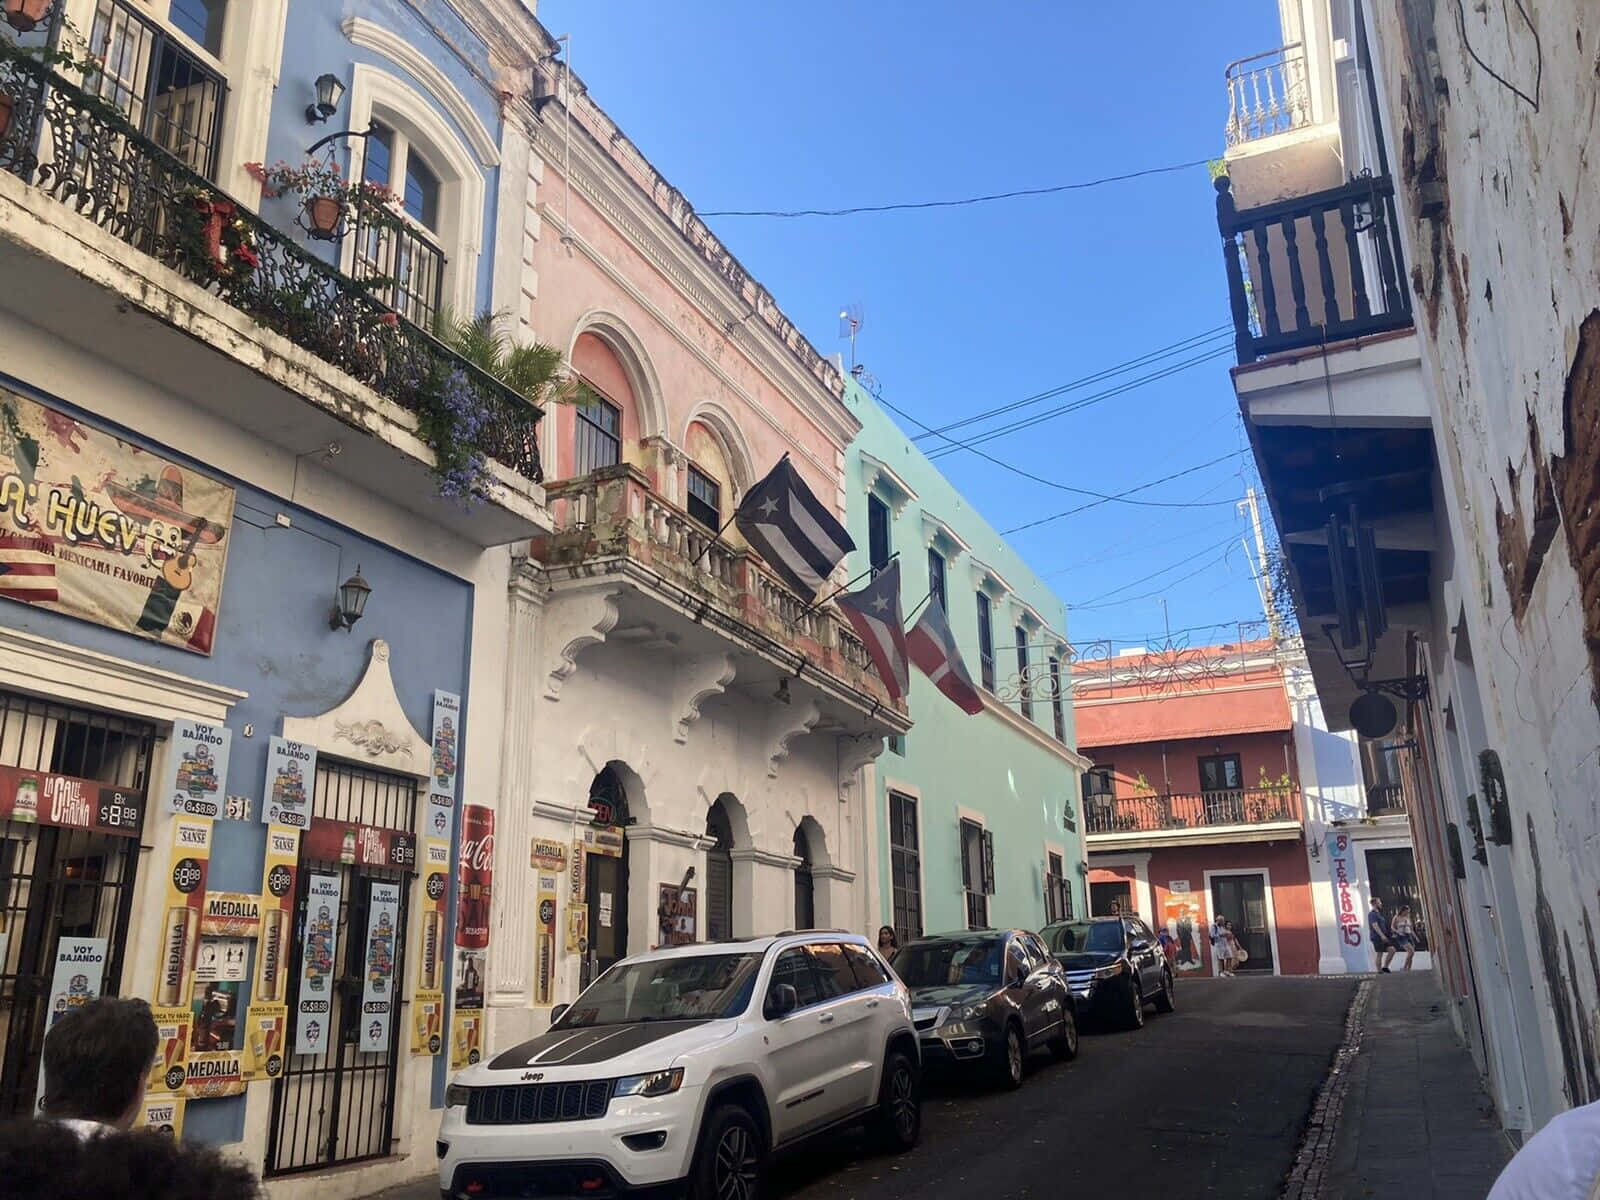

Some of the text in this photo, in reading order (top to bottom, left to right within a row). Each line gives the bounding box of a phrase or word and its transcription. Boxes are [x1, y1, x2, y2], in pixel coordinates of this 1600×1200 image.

[182, 729, 223, 745] BAJANDO
[195, 723, 214, 736] VOY
[286, 740, 302, 751] VOY
[277, 746, 310, 762] BAJANDO
[535, 843, 562, 858] MEDALLA
[208, 900, 258, 917] MEDALLA
[1340, 924, 1362, 947] 15
[74, 945, 93, 954] VOY
[166, 923, 185, 986] MEDALLA
[263, 925, 280, 982] MEDALLA
[59, 954, 103, 963] BAJANDO
[187, 1059, 239, 1077] MEDALLA
[520, 1071, 544, 1081] Jeep
